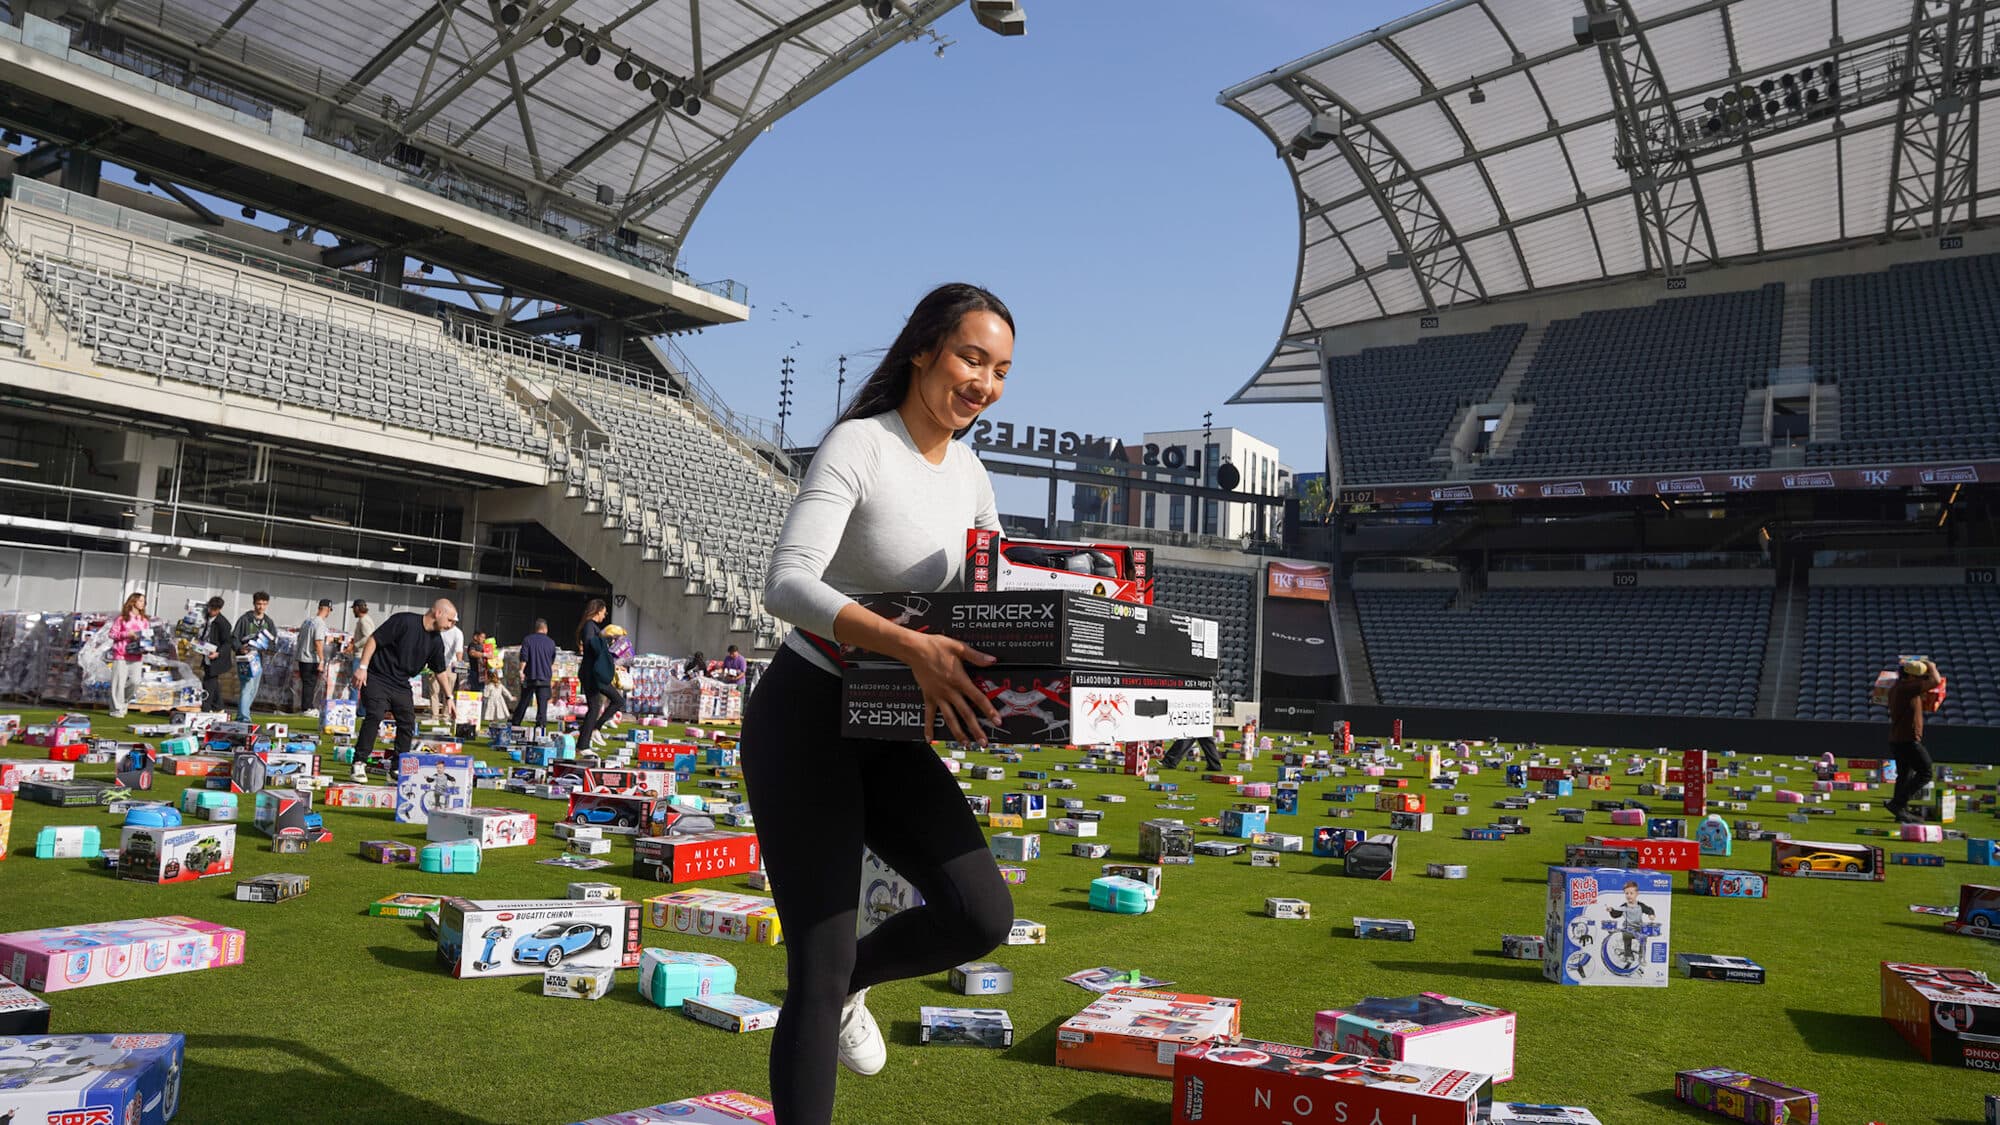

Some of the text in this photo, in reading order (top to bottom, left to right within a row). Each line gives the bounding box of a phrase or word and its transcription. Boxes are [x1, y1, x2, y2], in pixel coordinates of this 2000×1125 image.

[1669, 280, 1685, 288] 209
[1422, 319, 1438, 328] 208
[1730, 475, 1757, 489] TKF
[1861, 470, 1891, 485] TKF
[1496, 484, 1518, 498] TKF
[1608, 480, 1633, 494] TKF
[1343, 491, 1371, 504] 11:07
[1272, 572, 1295, 589] TKF
[1616, 575, 1635, 585] 109
[1969, 571, 1993, 583] 110
[952, 603, 1055, 620] STRIKER-X
[1076, 676, 1112, 685] QUADCOPTER
[1112, 677, 1120, 685] RC
[848, 701, 883, 709] DRONE
[848, 709, 945, 727] SRIKER-X
[694, 846, 728, 859] MIKE
[1644, 848, 1687, 856] TYSO
[685, 858, 736, 874] TYSON
[1640, 857, 1677, 865] MIKE
[1572, 878, 1598, 890] Kid's
[1572, 889, 1598, 900] Band
[380, 906, 422, 918] SUBWAY
[516, 910, 574, 920] BUGATTI CHIRON
[228, 934, 236, 962] QUEEN
[1726, 970, 1760, 978] HORNET
[982, 977, 996, 989] DC
[1966, 1048, 2000, 1060] OXING
[1191, 1076, 1204, 1120] ALL-STAR
